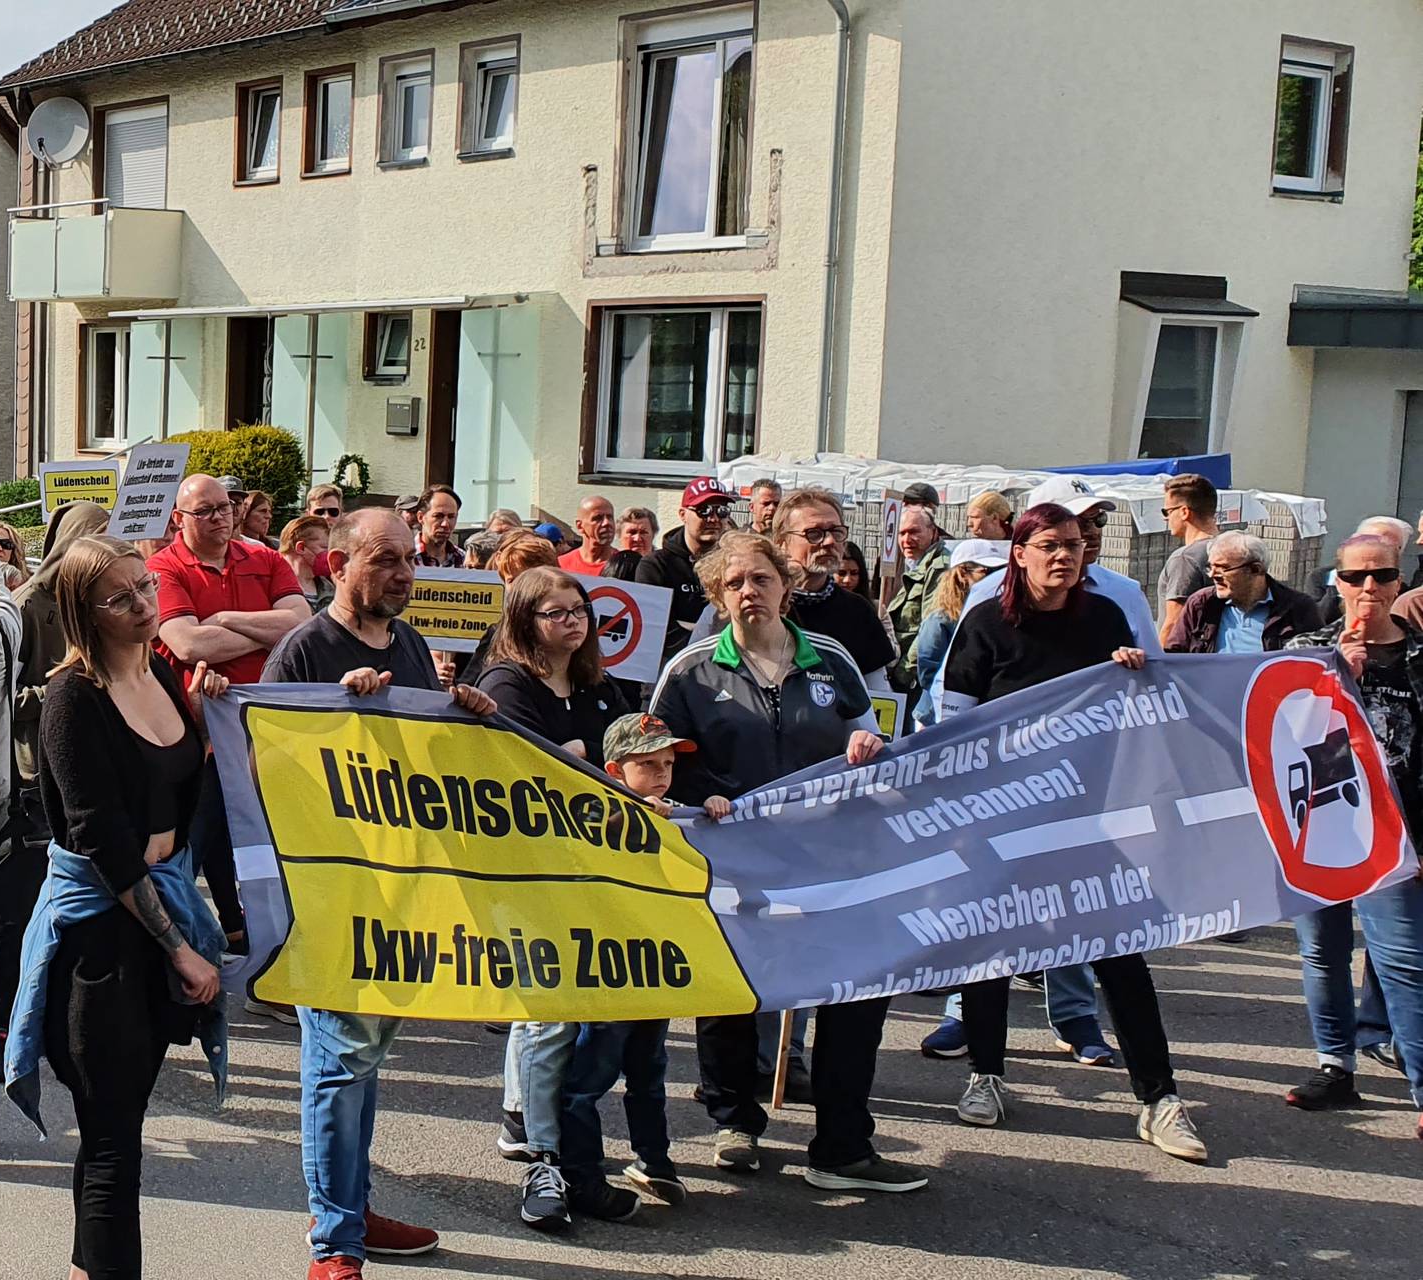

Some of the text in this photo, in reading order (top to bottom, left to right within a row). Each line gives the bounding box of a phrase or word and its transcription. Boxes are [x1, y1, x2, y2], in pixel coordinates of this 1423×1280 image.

[414, 338, 426, 351] 22
[53, 475, 110, 487] Lüdenscheid
[409, 615, 488, 632] Lkw-freie Zone
[936, 737, 991, 779] aus
[997, 681, 1190, 763] Lüdenscheid
[884, 758, 1087, 846] verbannen!
[897, 863, 1154, 946] Menschen an der
[569, 927, 693, 990] Zone
